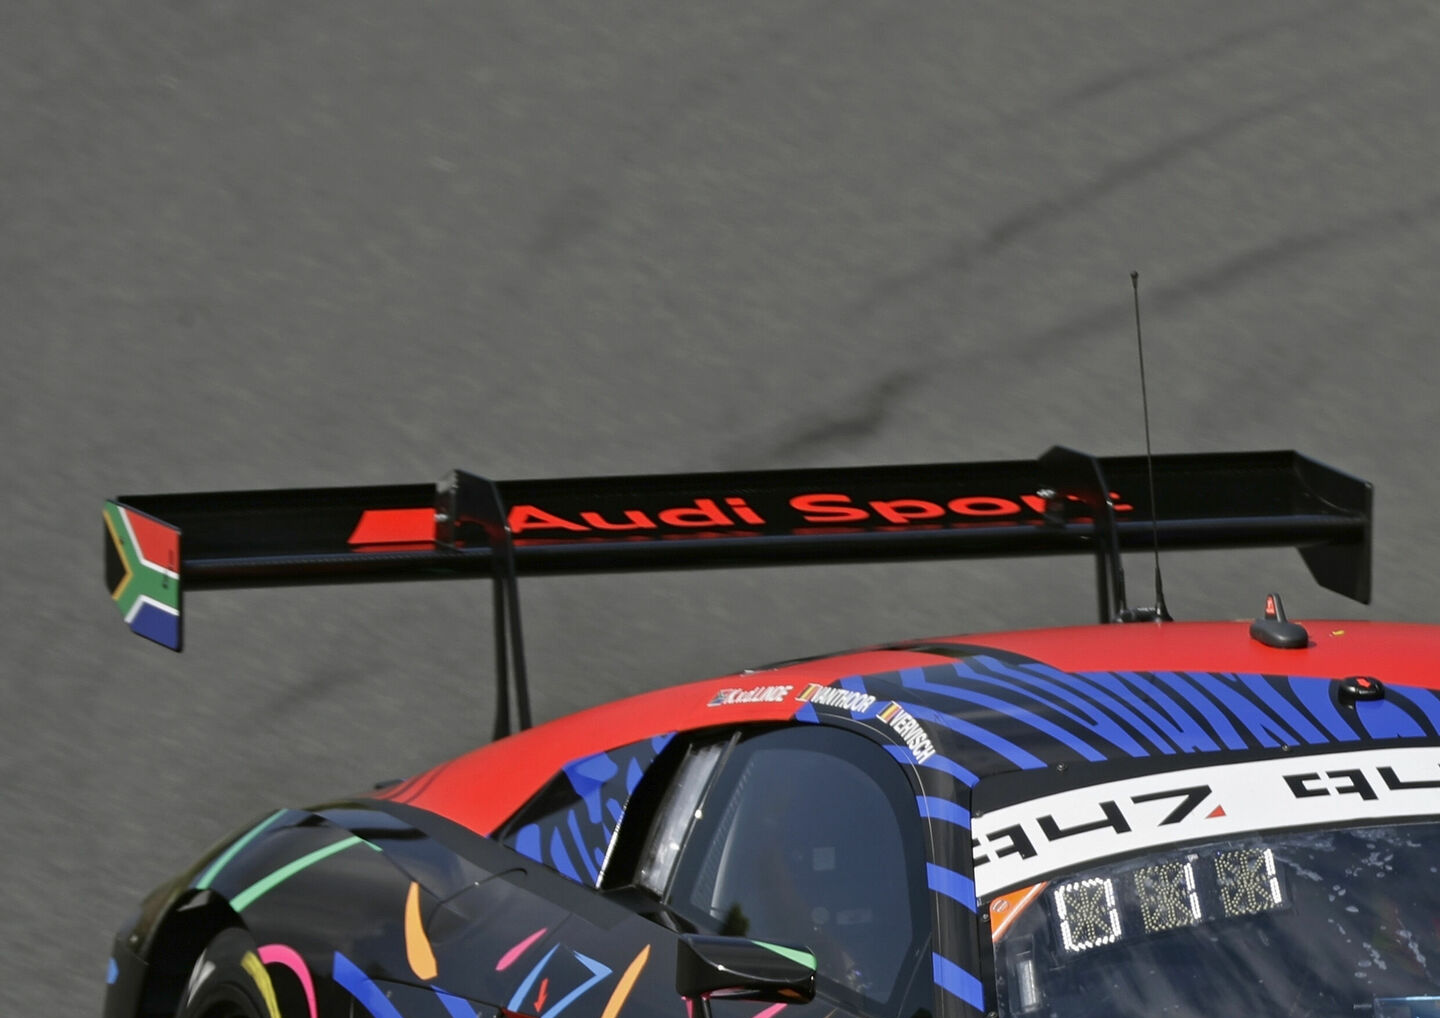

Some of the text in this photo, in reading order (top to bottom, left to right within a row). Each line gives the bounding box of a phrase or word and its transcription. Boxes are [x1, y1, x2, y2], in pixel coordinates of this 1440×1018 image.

[507, 497, 766, 534] Audi
[811, 685, 877, 714] VANTHOOR
[890, 709, 936, 765] VERVISCH
